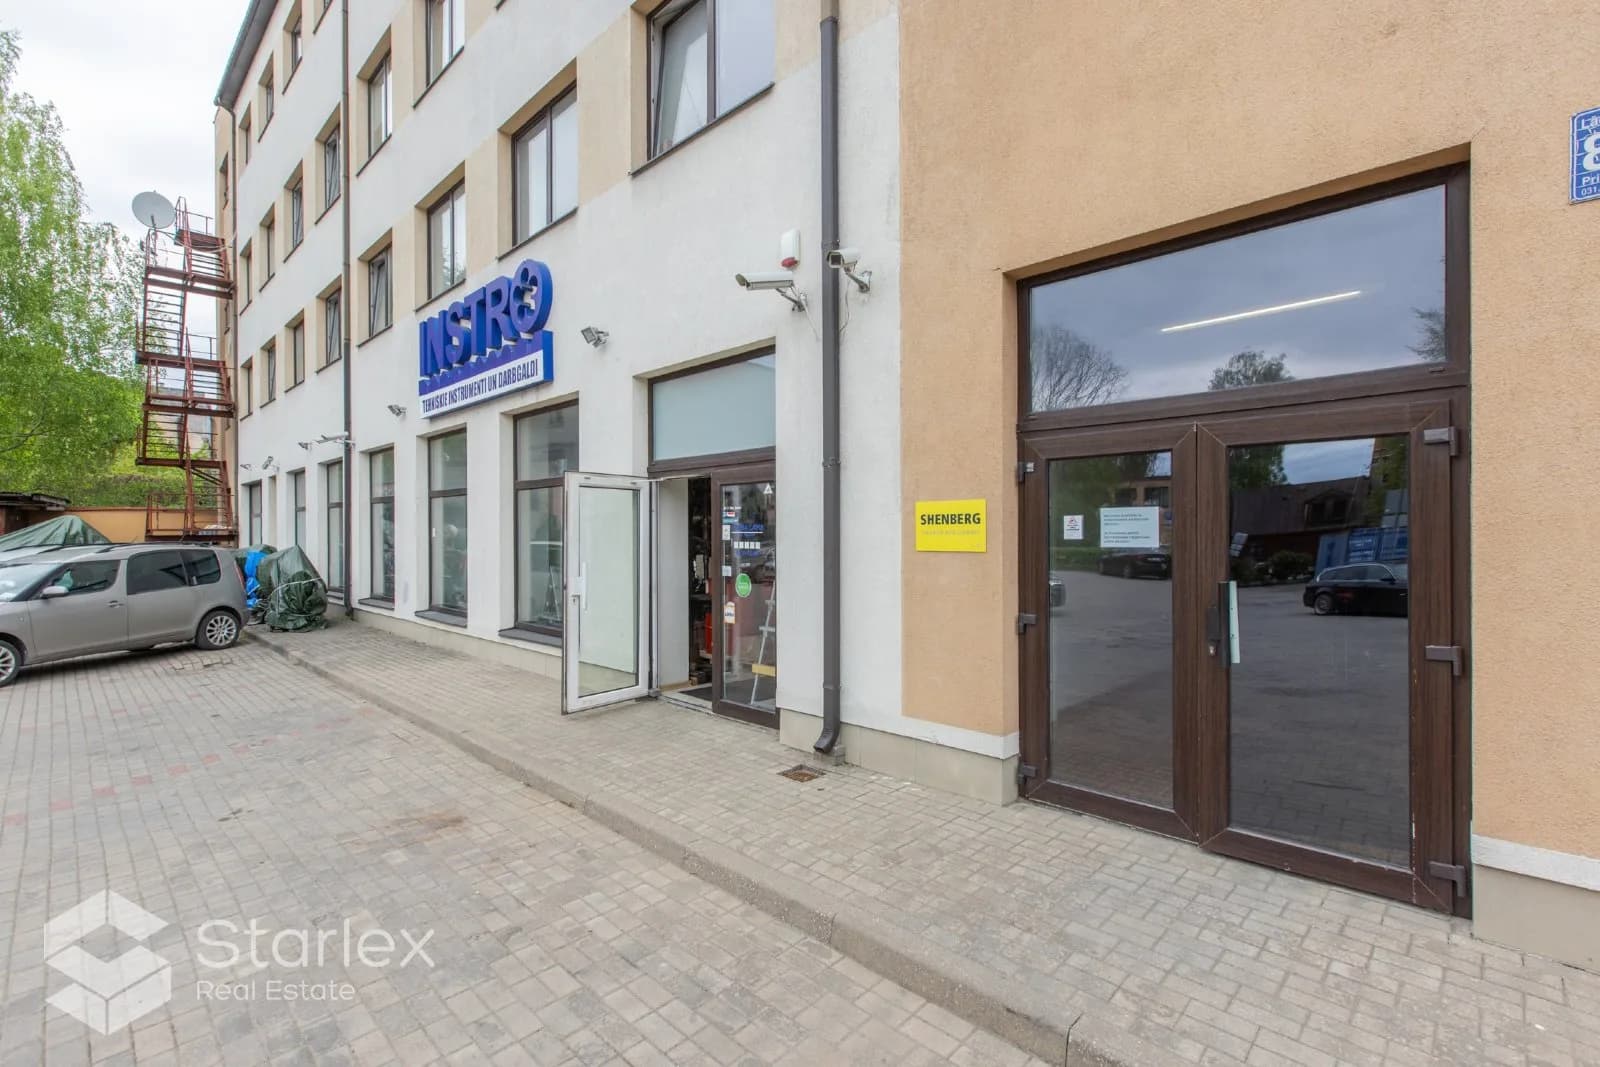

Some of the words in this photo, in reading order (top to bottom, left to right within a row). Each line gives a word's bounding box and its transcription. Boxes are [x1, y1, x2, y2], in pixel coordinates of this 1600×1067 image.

[419, 258, 553, 378] INSTRO
[448, 378, 487, 405] INSTRUMENTI
[488, 373, 497, 392] UN
[498, 358, 538, 388] DARBGALDI
[920, 512, 981, 526] SHENBERG
